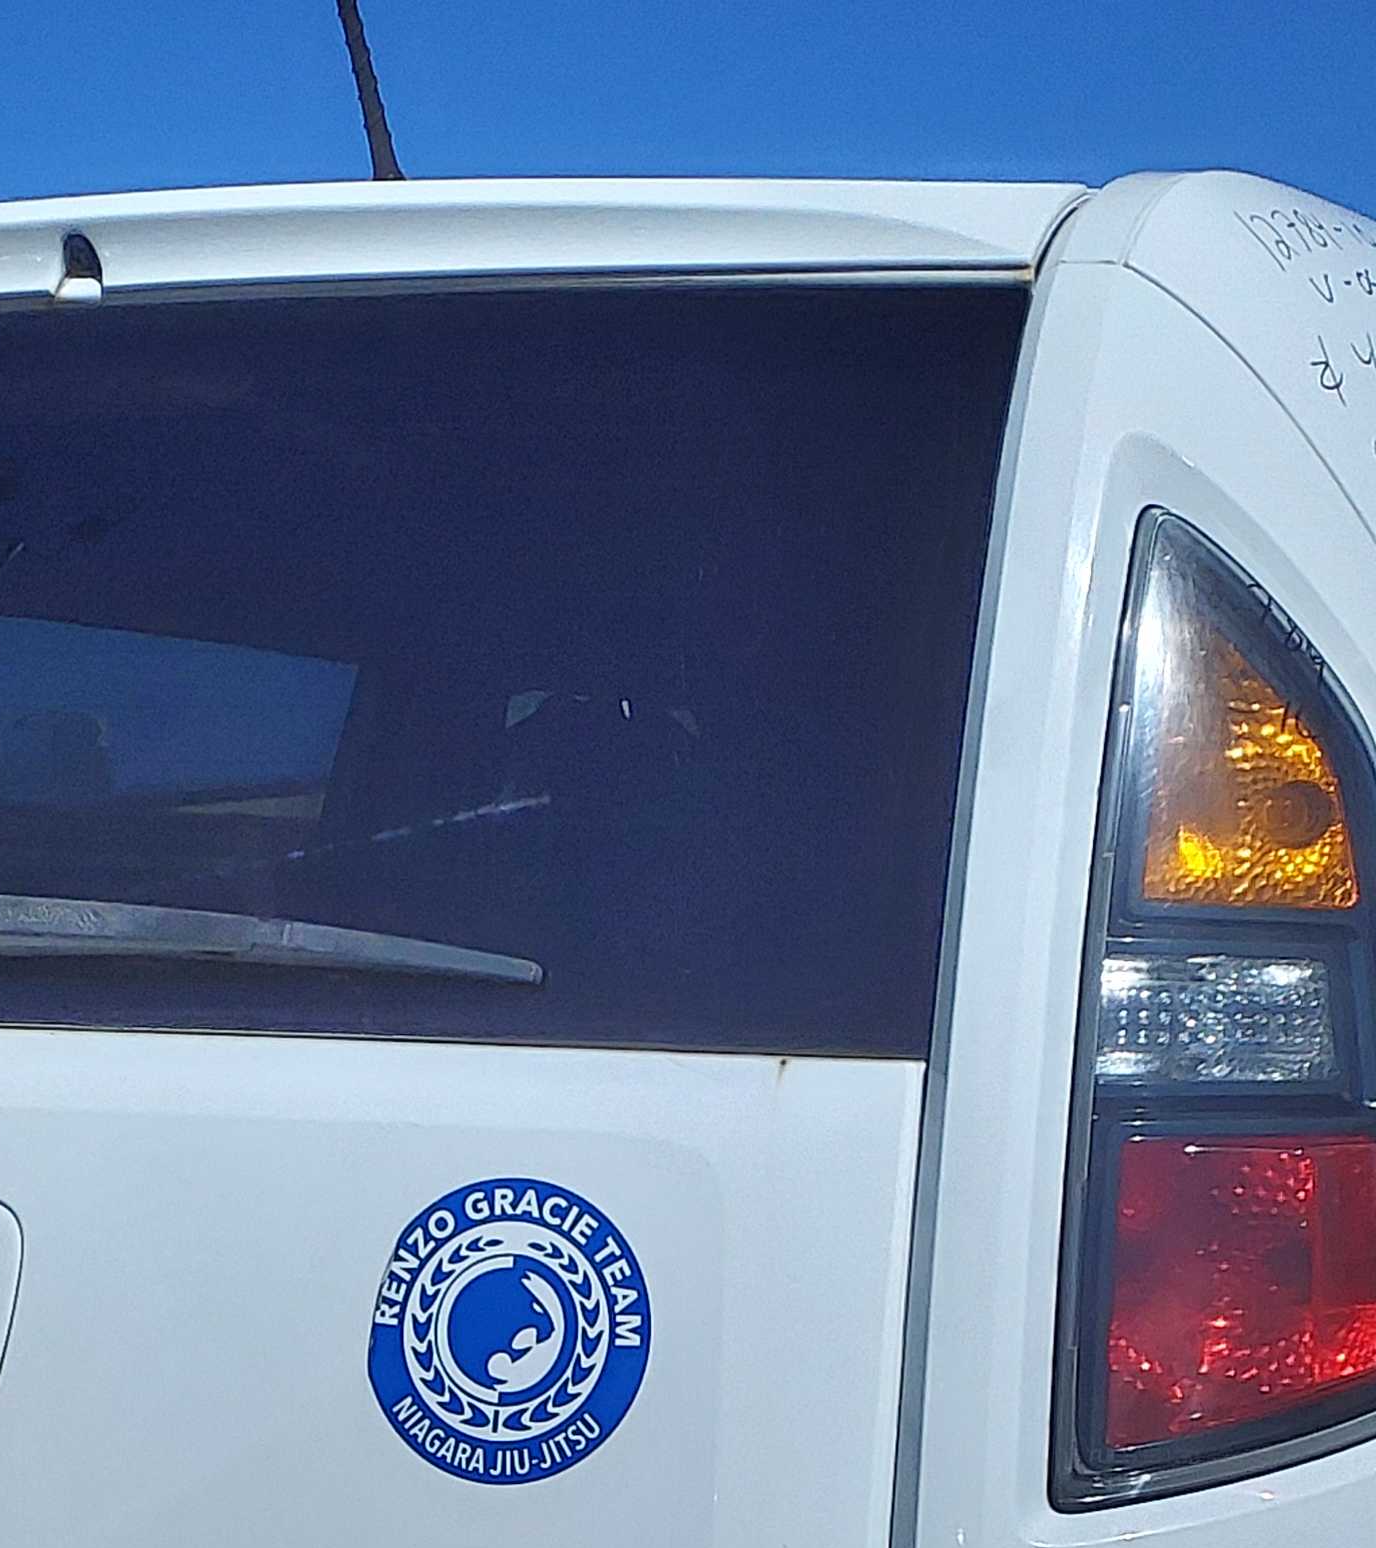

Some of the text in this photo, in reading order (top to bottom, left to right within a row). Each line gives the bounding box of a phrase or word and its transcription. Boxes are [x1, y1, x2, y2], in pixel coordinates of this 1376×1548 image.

[374, 1188, 642, 1347] RENZO GRACIE TEAM
[391, 1394, 603, 1477] NIAGARA JIU-JITSU
